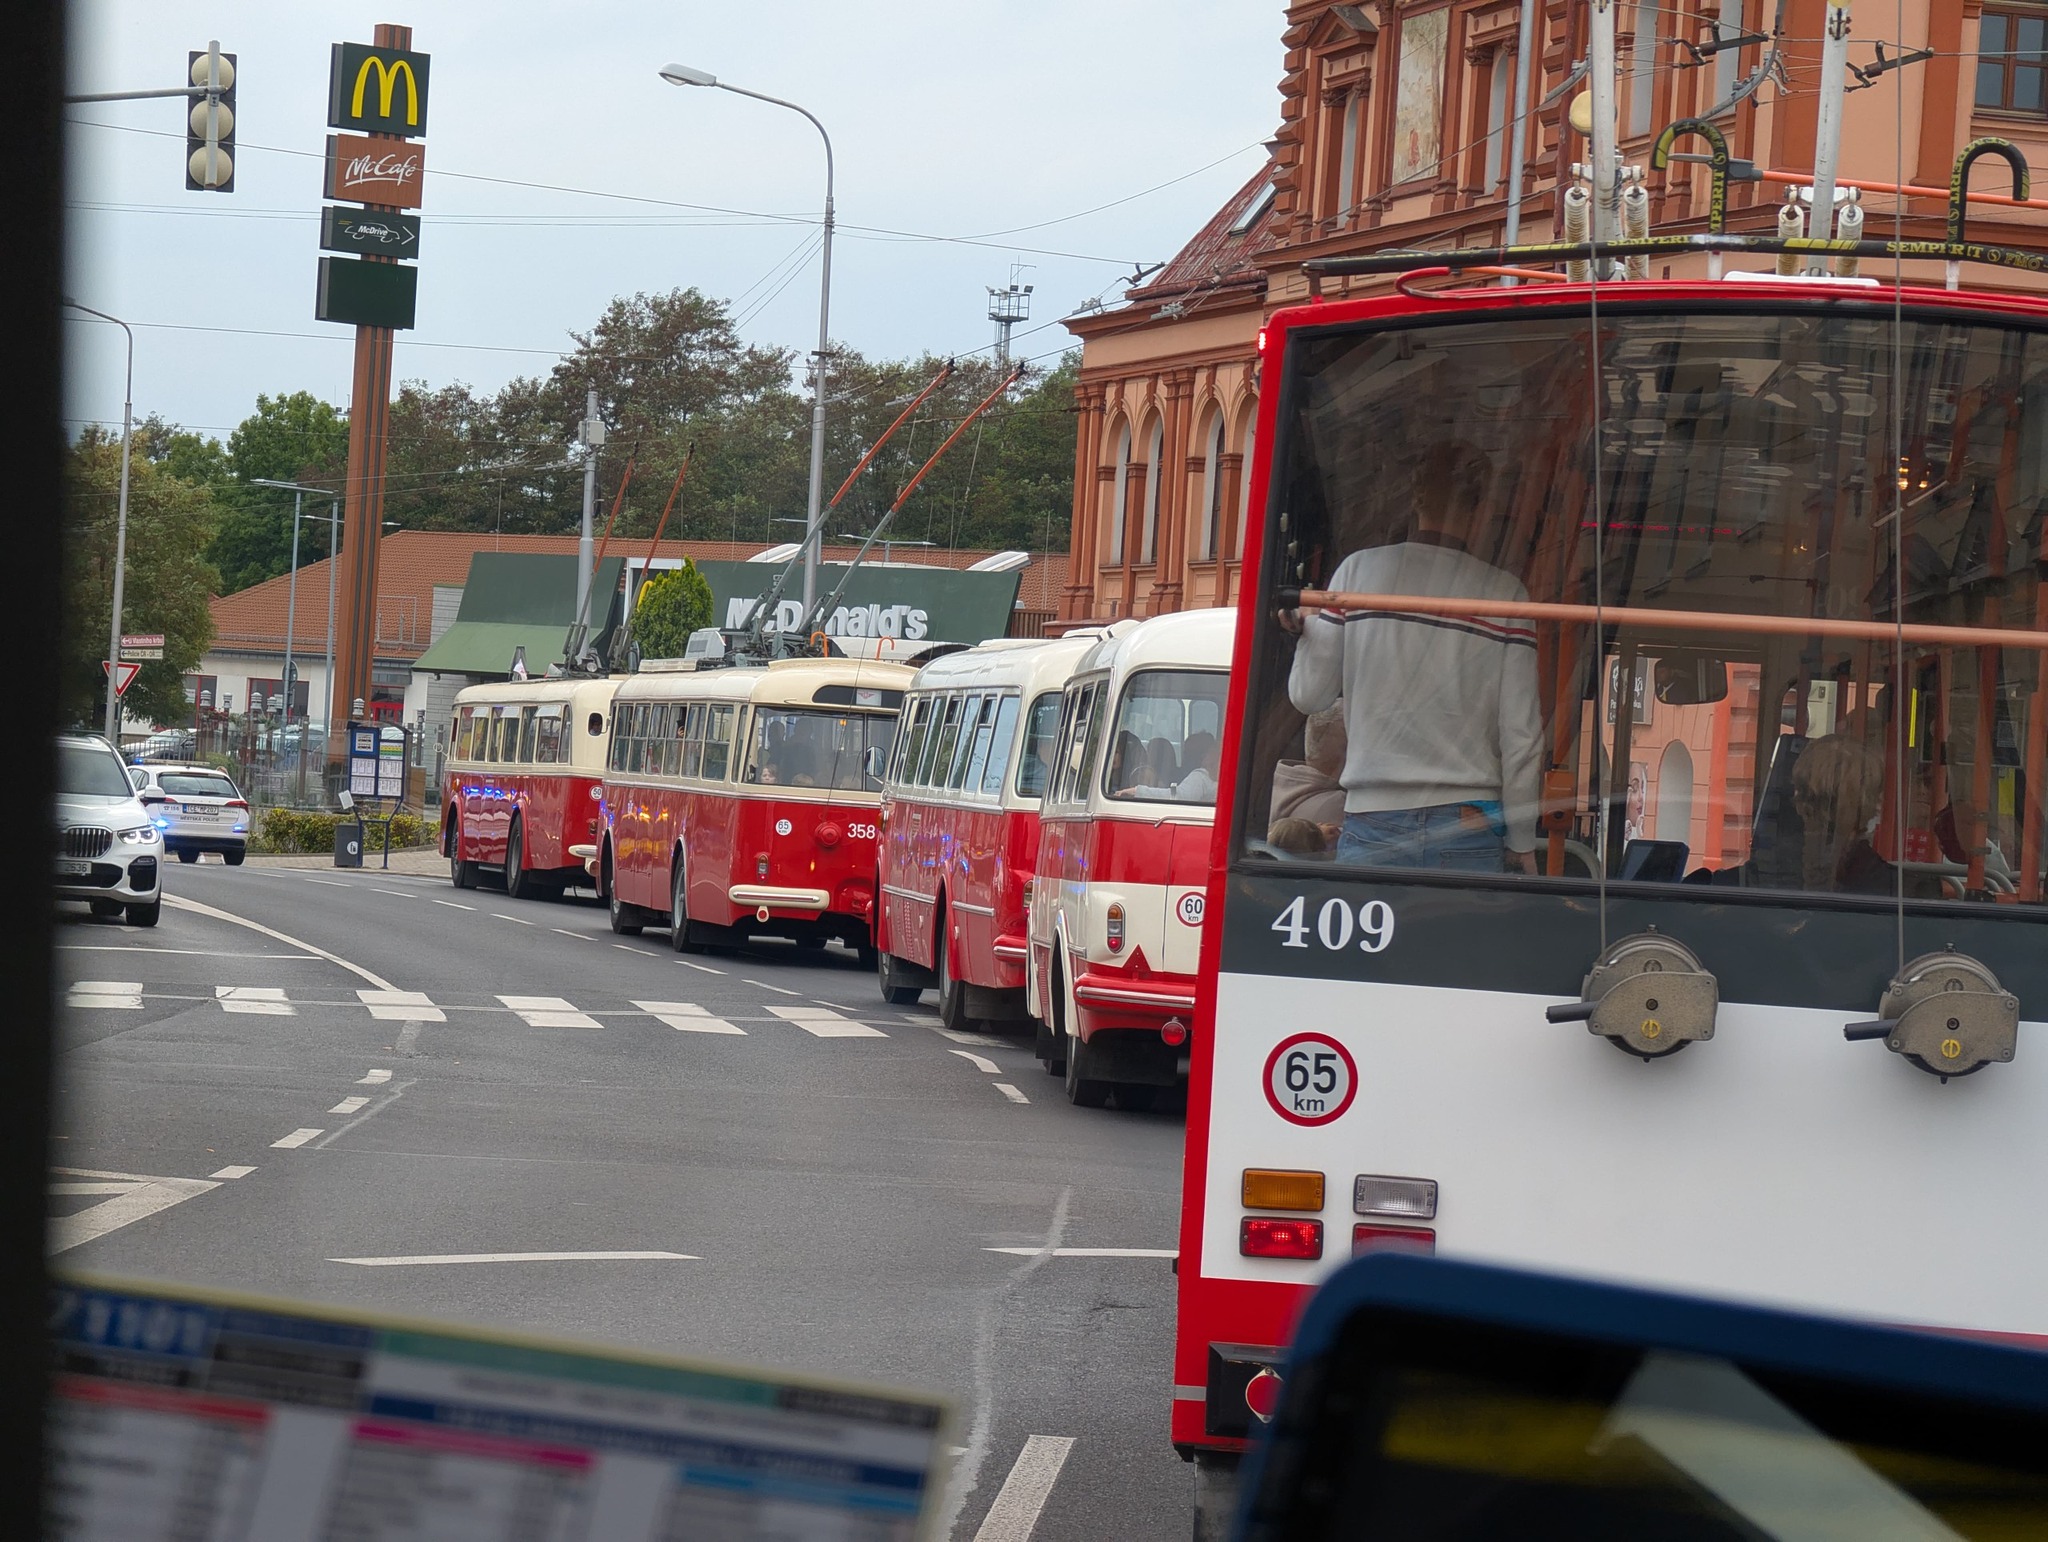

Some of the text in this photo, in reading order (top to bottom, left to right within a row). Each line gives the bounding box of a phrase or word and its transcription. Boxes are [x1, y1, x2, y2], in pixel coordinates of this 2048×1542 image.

[344, 153, 417, 186] McCafé
[358, 225, 388, 236] McDrive
[778, 821, 789, 830] 65
[847, 823, 876, 839] 358
[1185, 898, 1203, 914] 60
[1188, 914, 1199, 922] km
[1271, 896, 1395, 953] 409
[1285, 1051, 1337, 1094] 65
[1294, 1093, 1325, 1112] km
